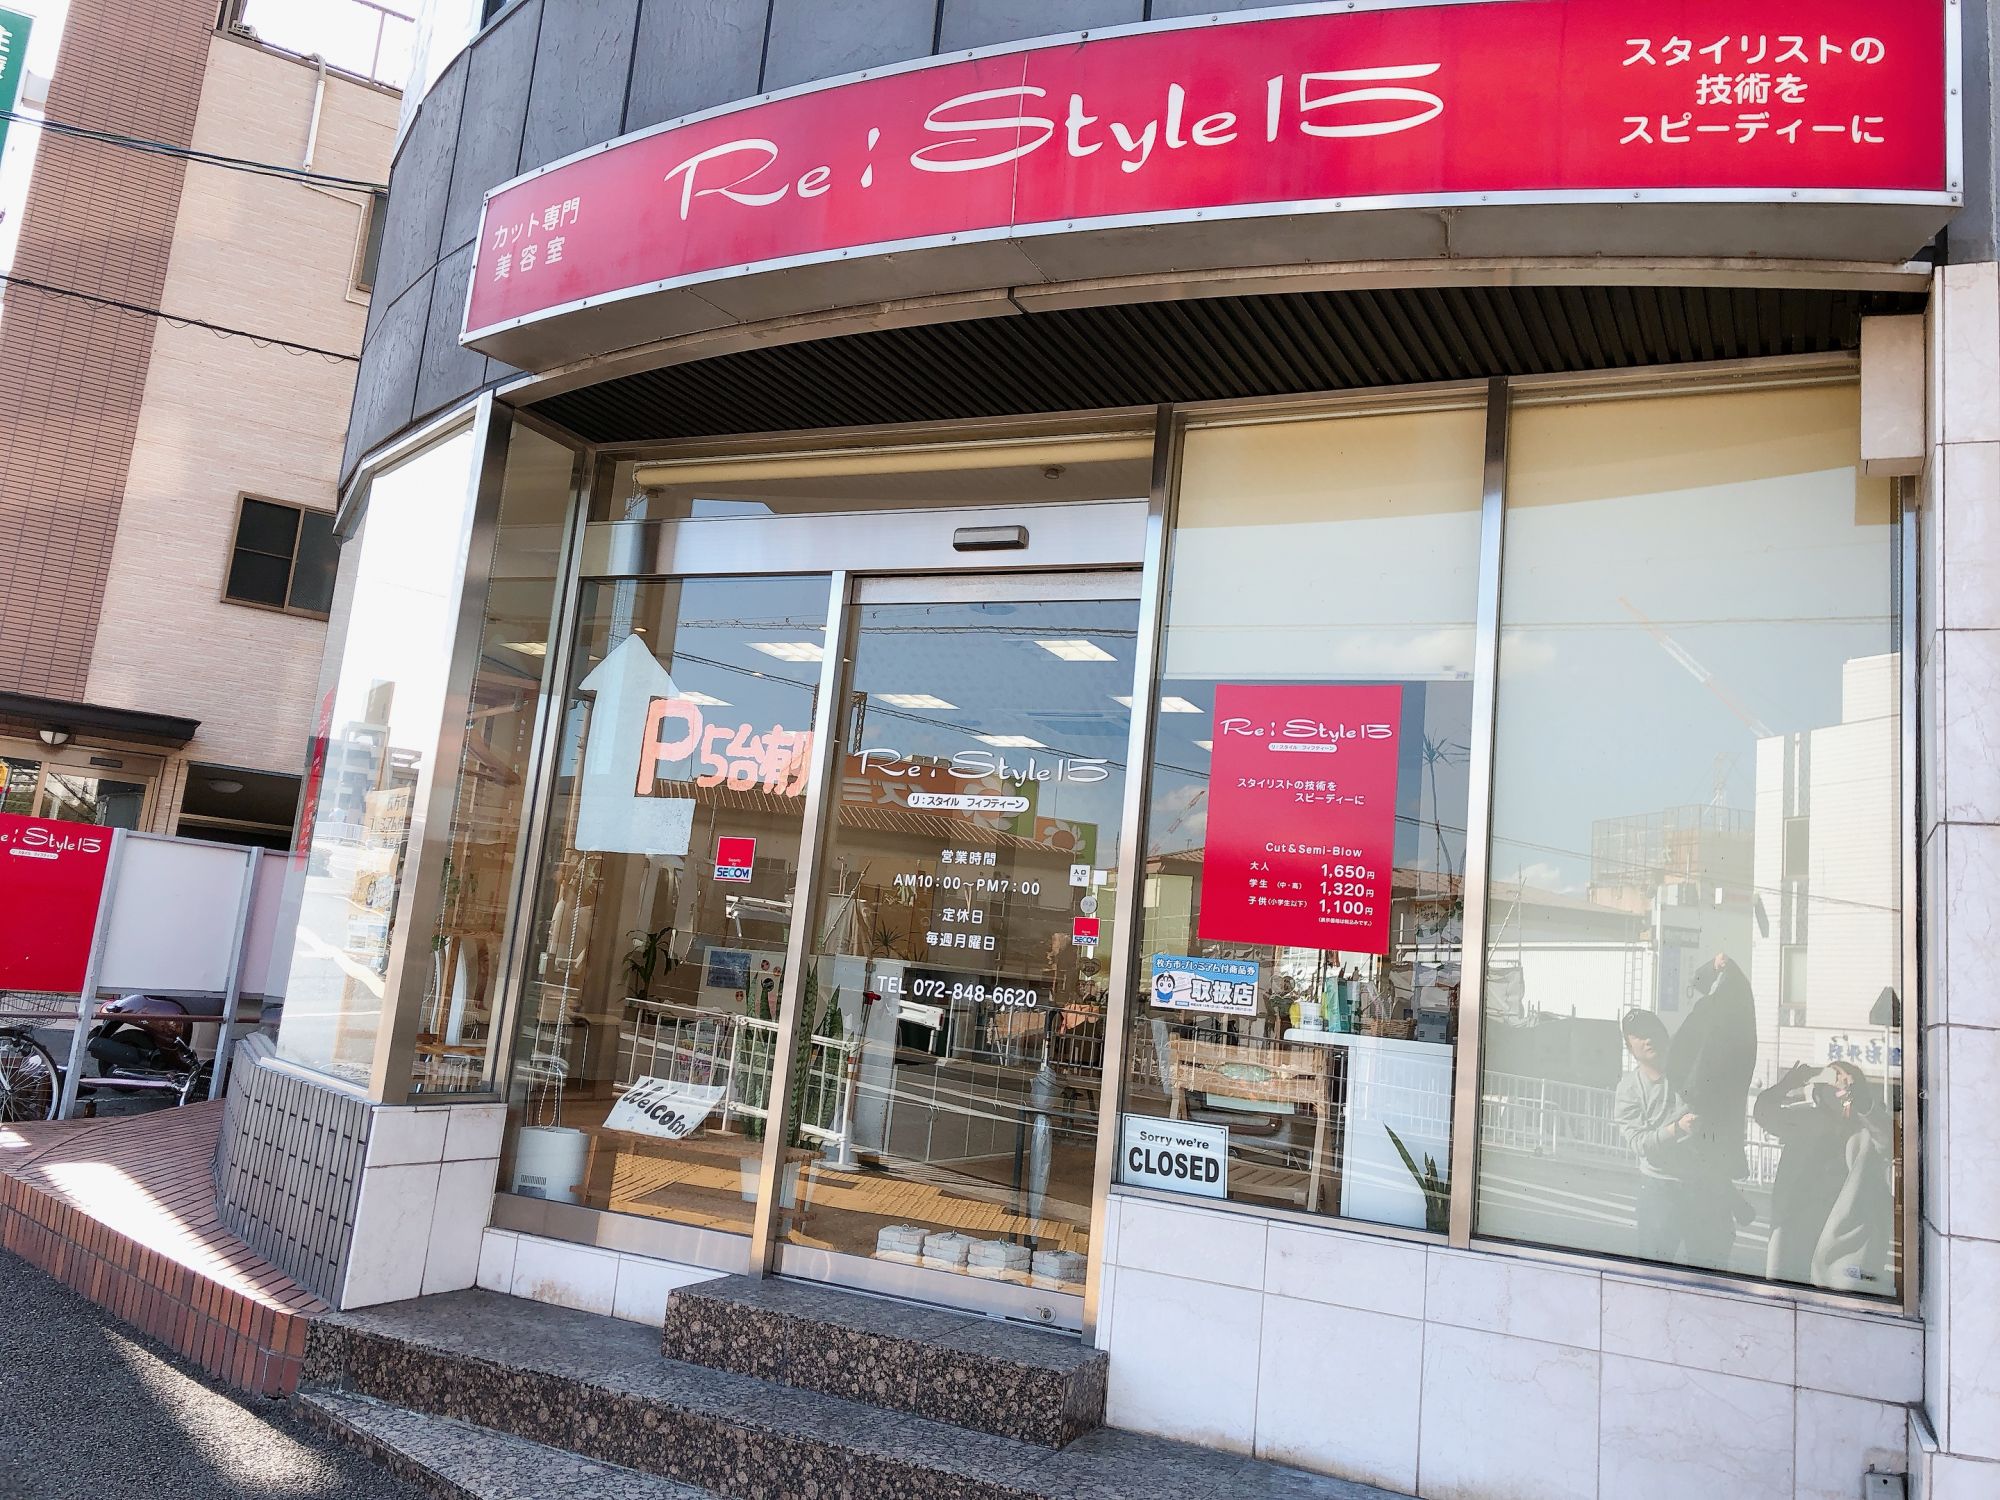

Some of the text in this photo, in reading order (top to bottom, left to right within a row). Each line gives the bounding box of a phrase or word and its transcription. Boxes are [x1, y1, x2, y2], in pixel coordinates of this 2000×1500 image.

[1622, 35, 1885, 66] スタイリストの
[1696, 73, 1808, 105] 技術を
[1619, 112, 1885, 144] スピーディーに
[492, 197, 580, 251] カット専門
[494, 236, 566, 282] 美容室
[1237, 778, 1337, 791] スタイリストの技術を
[1295, 793, 1365, 805] スピーディーに
[941, 850, 997, 866] 営業時間
[716, 867, 750, 878] SECOM
[1321, 863, 1375, 880] 1,650円
[1320, 881, 1375, 898] 1,320円
[942, 908, 983, 924] 定休日
[1319, 899, 1373, 916] 1,100円
[926, 931, 995, 951] 毎週月曜日
[877, 976, 1037, 1007] TEL 072-848-6620
[1190, 979, 1255, 1007] 取扱店
[1140, 1130, 1209, 1149] Sorry we're
[1128, 1146, 1220, 1183] CLOSED
